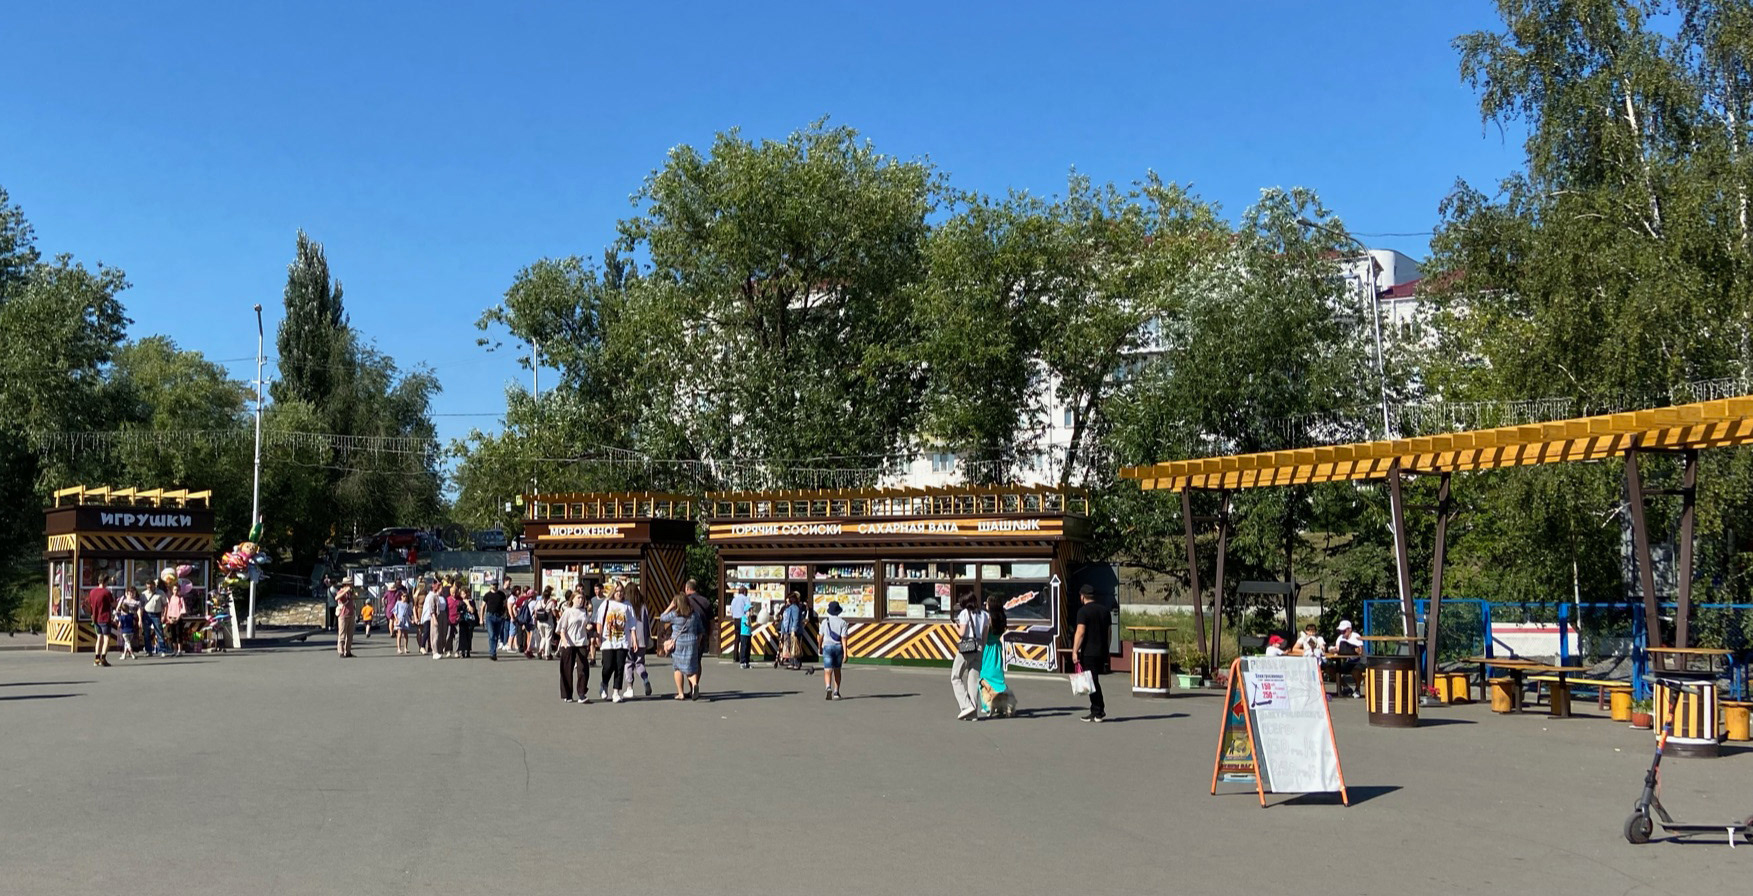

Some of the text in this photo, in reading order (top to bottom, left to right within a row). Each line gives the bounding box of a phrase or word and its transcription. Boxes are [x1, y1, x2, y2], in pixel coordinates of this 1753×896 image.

[100, 512, 192, 527] ИГРУШКИ
[977, 519, 1041, 532] ШАШЛЫК
[549, 526, 620, 537] МОРОЖЕНОЕ
[731, 524, 842, 536] ГОРЯЧИЕ СОСИСКИ
[857, 522, 959, 534] САХАРНАЯ ВАТА
